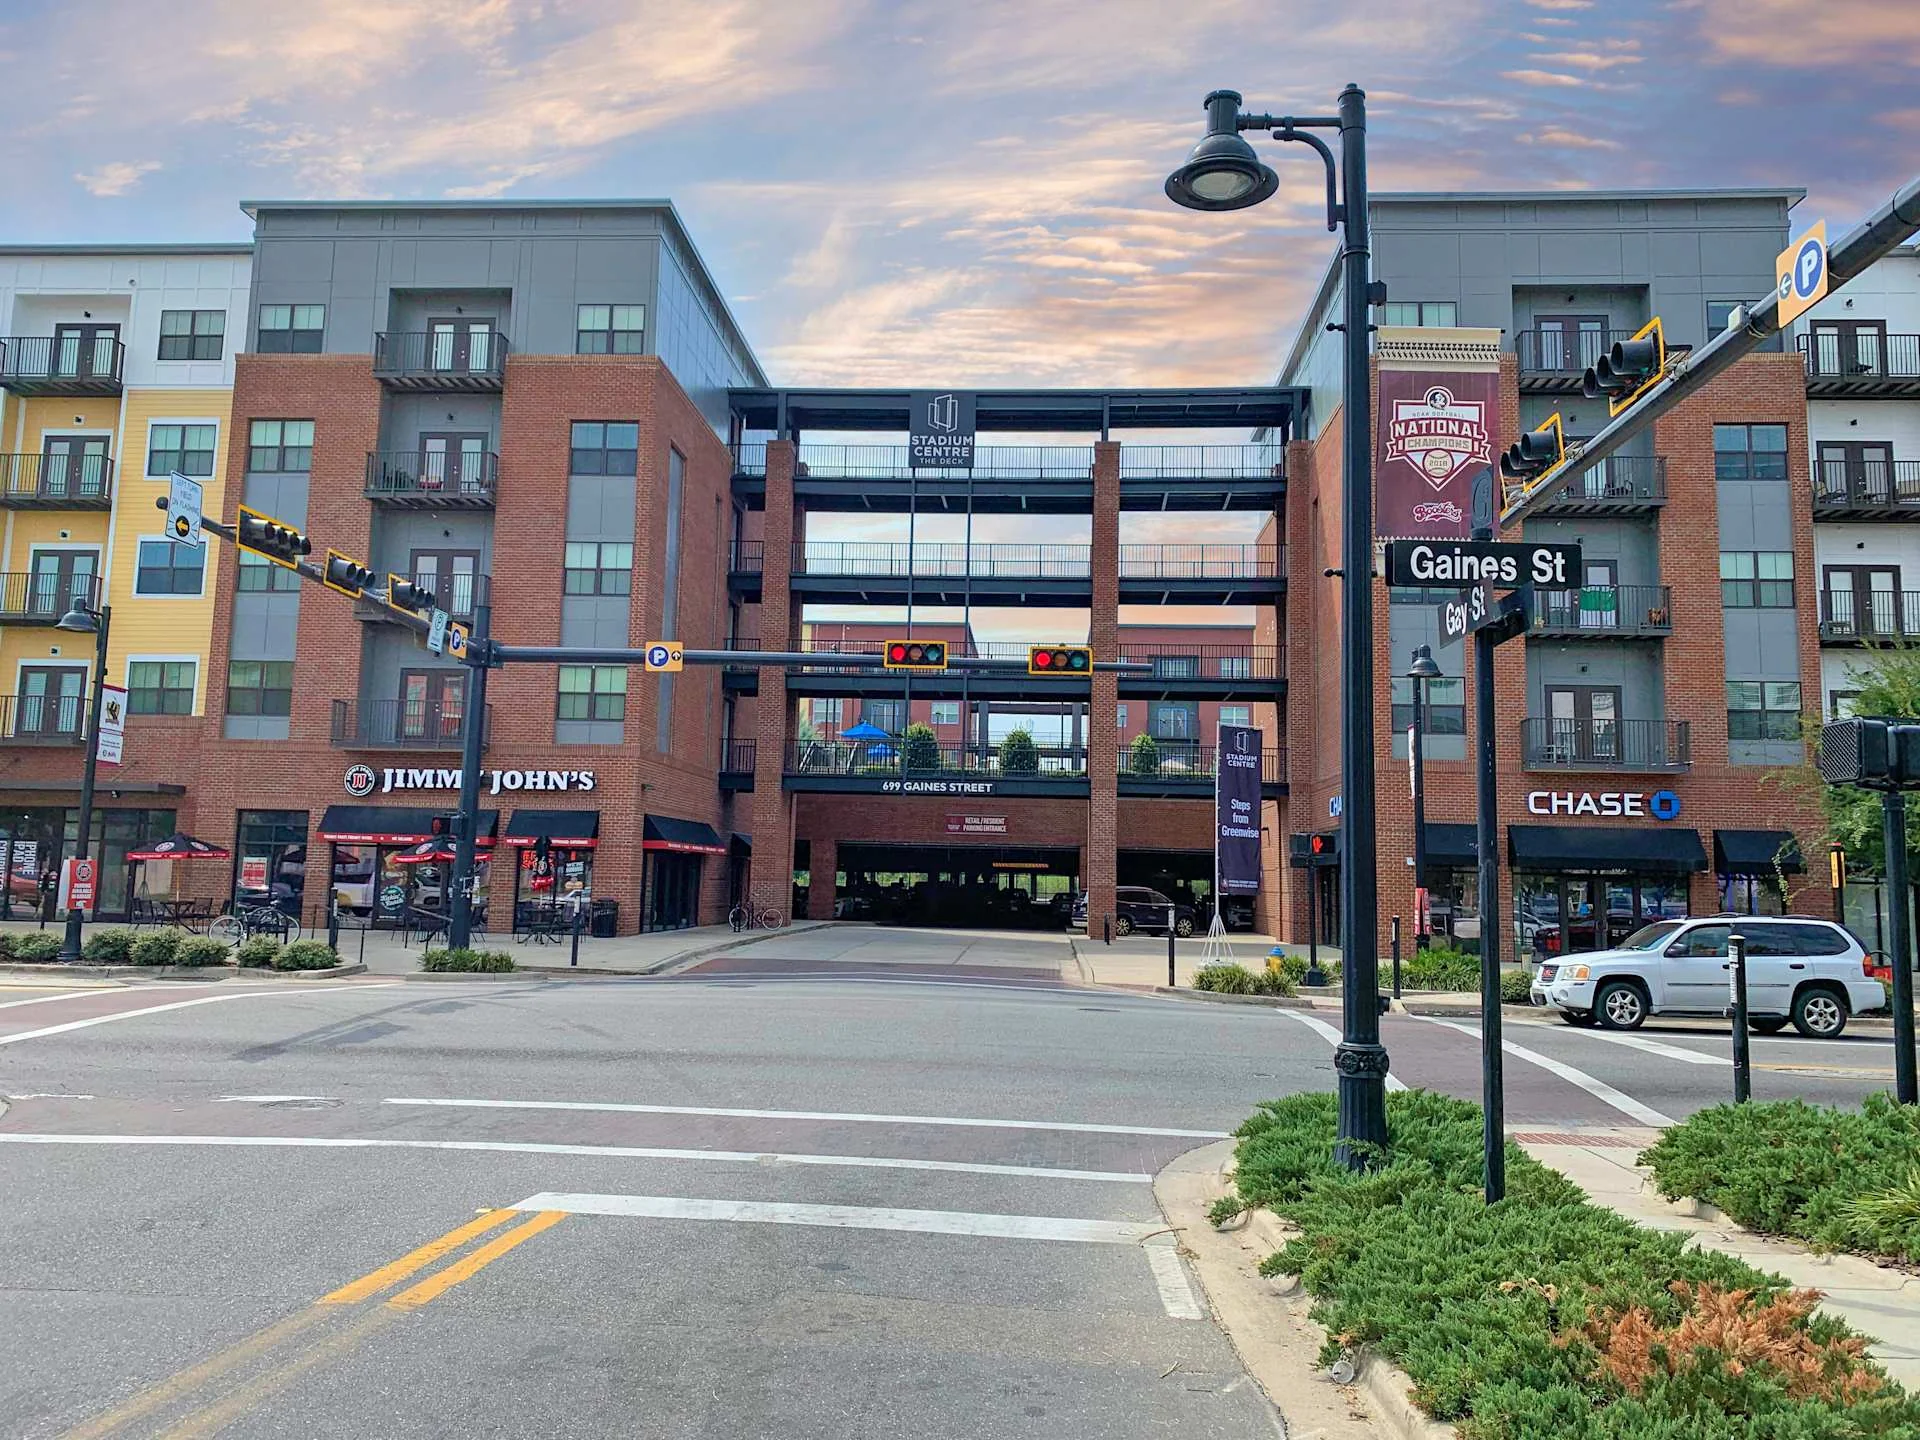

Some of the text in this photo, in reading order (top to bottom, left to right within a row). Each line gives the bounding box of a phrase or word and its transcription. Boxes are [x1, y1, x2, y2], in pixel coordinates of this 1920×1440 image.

[1802, 249, 1818, 290] P
[1395, 419, 1484, 439] NATIONAL
[912, 435, 973, 446] STADIUM
[1407, 438, 1470, 450] CHAMPIONS
[914, 446, 970, 457] CENTRE
[920, 457, 964, 465] THE DECK
[1429, 459, 1448, 467] 2018
[1410, 545, 1566, 583] Gaines St
[1445, 585, 1486, 636] Gay St
[653, 649, 666, 664] P
[1226, 753, 1257, 762] STADIUM
[1227, 760, 1256, 769] CENTRE
[382, 768, 594, 795] JIMM JOHN'S
[882, 782, 993, 793] 699 GAINES STREET
[1231, 799, 1251, 813] Steps
[1528, 791, 1645, 816] CHASE
[1232, 812, 1249, 824] from
[1221, 825, 1260, 838] Greenwise
[12, 841, 26, 863] IPAD
[22, 841, 37, 875] IPHONE
